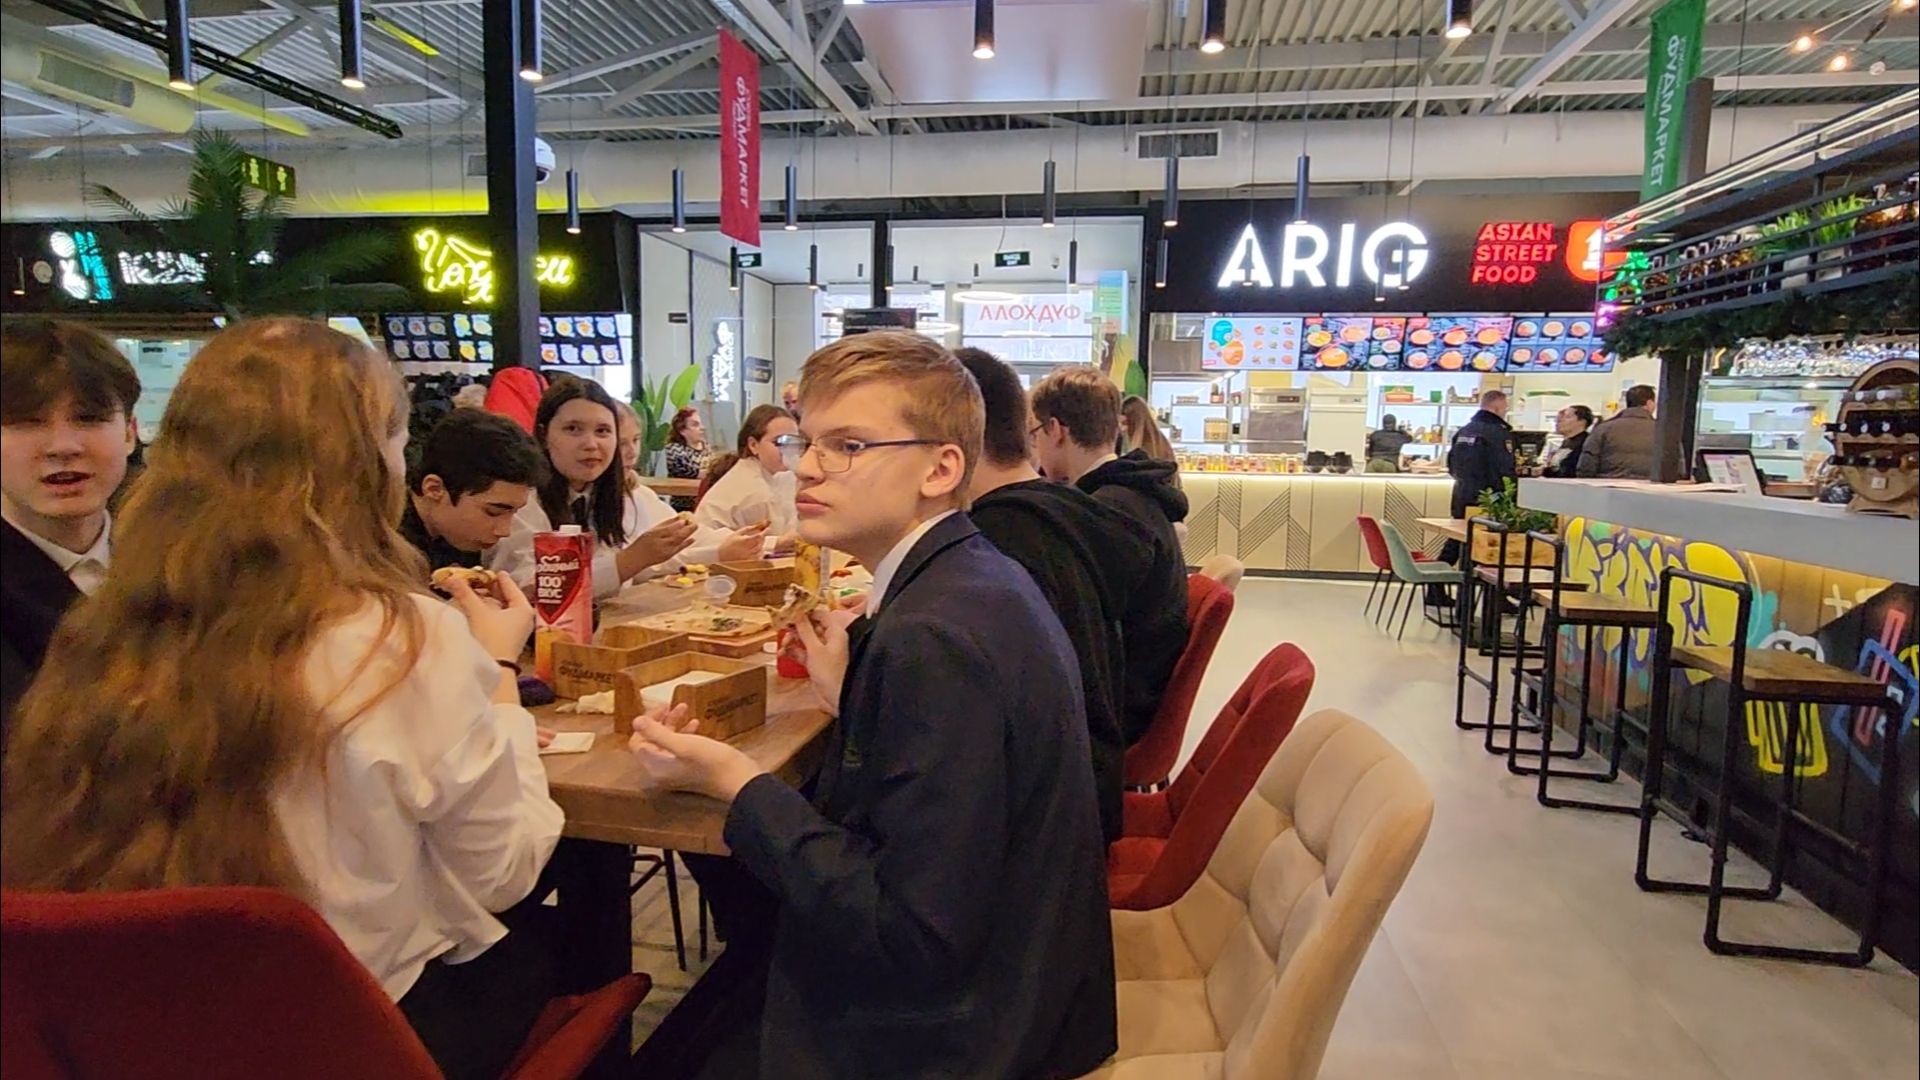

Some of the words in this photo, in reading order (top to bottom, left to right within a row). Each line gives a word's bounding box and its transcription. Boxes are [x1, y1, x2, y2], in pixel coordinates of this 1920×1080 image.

[1479, 223, 1554, 241] ASIAN
[1217, 222, 1429, 289] ARIG
[1475, 244, 1558, 262] STREET
[1471, 265, 1537, 283] FOOD
